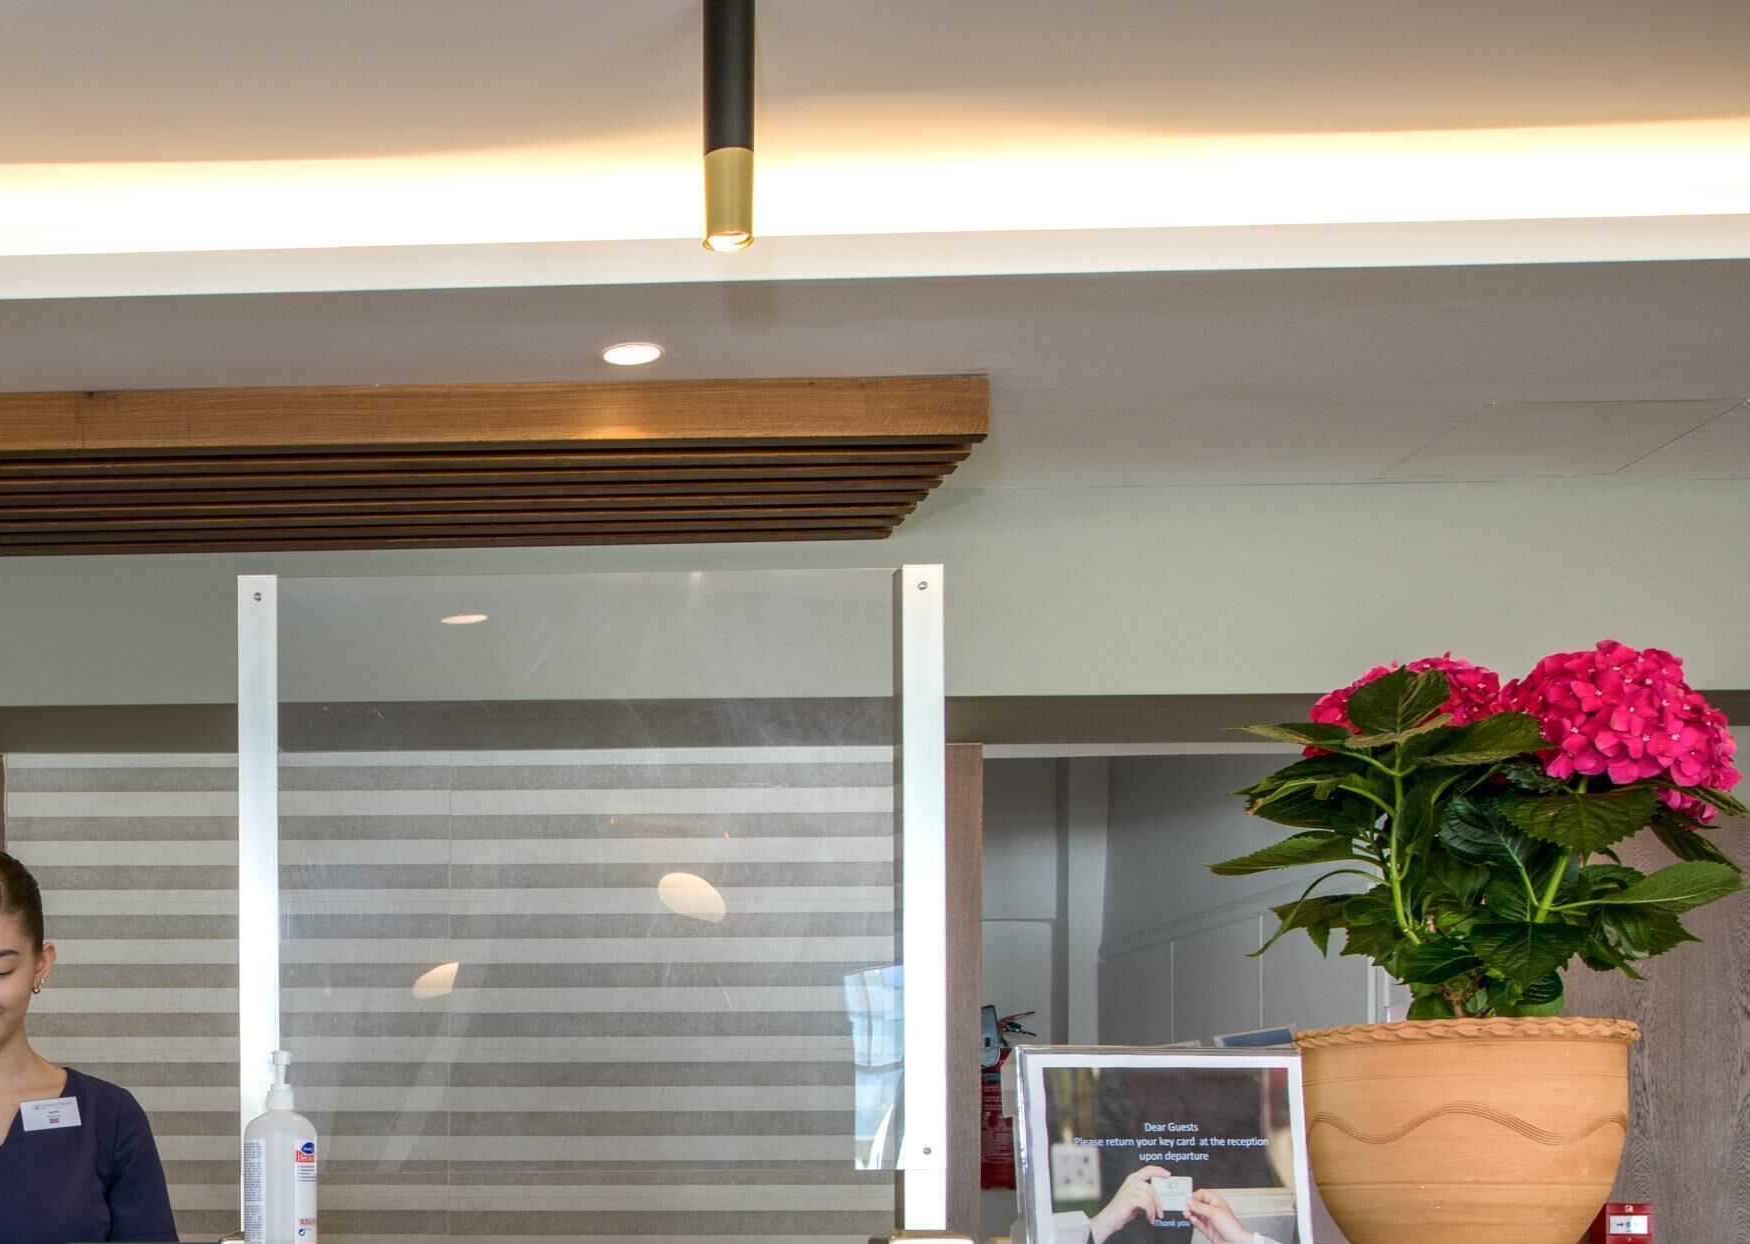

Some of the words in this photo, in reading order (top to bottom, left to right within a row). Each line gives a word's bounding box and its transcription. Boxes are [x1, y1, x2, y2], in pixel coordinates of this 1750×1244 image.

[1144, 1122, 1166, 1132] Dear
[1167, 1122, 1199, 1132] Guests
[1074, 1137, 1104, 1147] Please
[1105, 1138, 1135, 1147] return
[1136, 1139, 1157, 1148] your
[1158, 1137, 1175, 1148] key
[1176, 1137, 1196, 1146] card
[1199, 1138, 1209, 1146] at
[1210, 1137, 1226, 1146] the
[1227, 1137, 1269, 1148] reception
[1139, 1153, 1163, 1162] upon
[1164, 1151, 1209, 1162] departure
[1155, 1219, 1175, 1227] Thank
[1176, 1220, 1191, 1228] you
